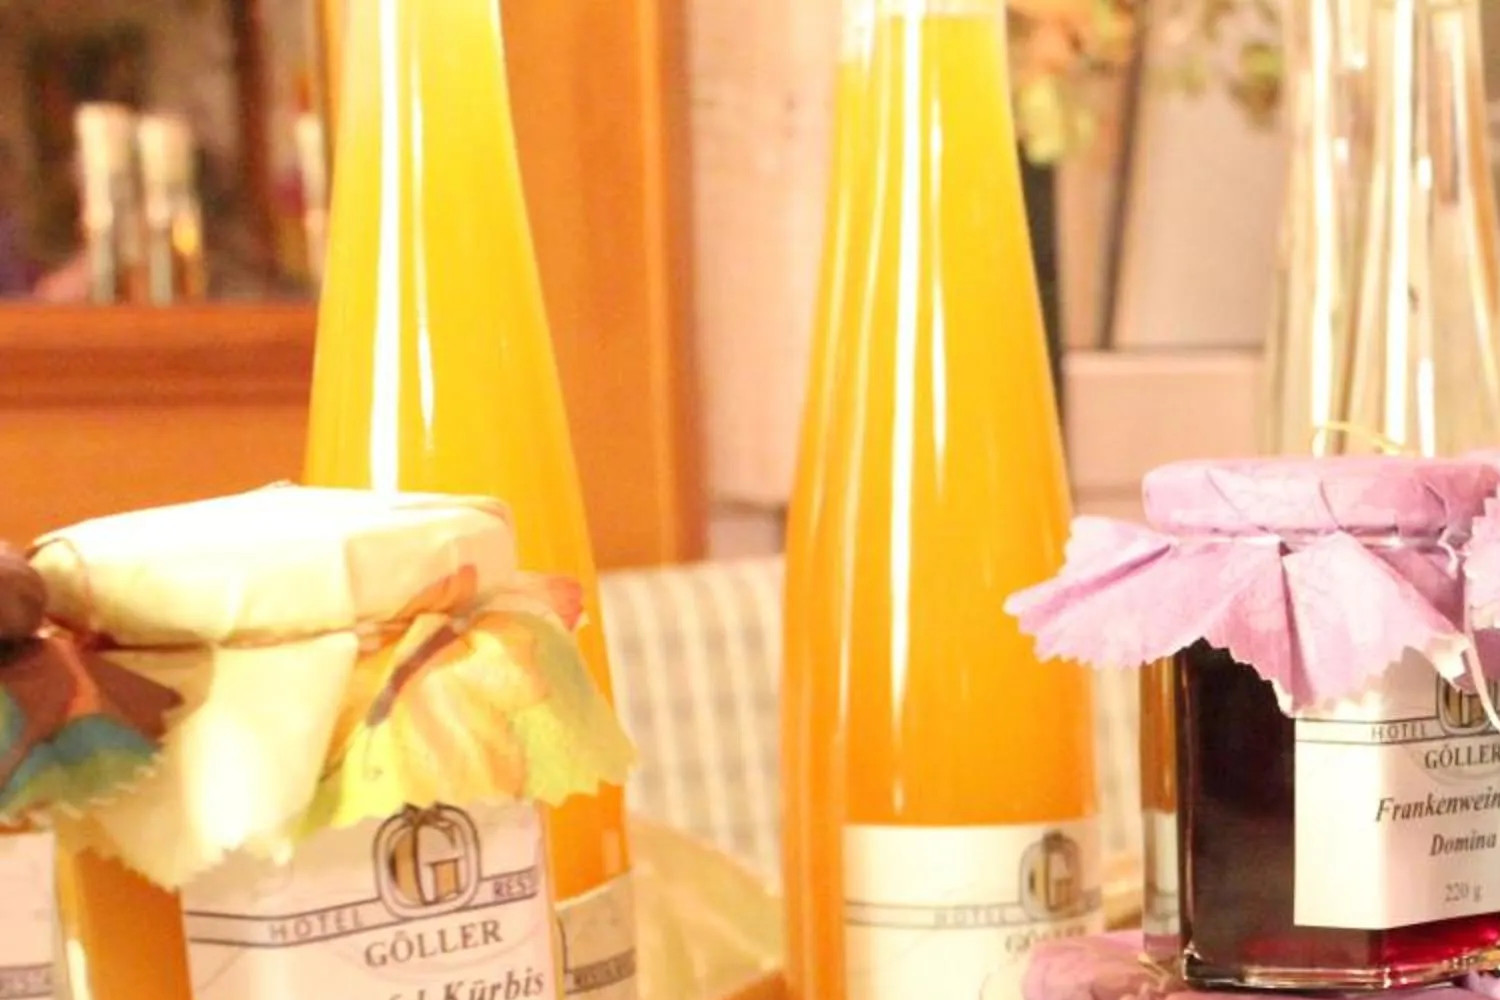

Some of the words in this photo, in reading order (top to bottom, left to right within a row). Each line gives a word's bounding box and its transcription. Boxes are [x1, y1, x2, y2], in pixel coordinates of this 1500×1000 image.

[1371, 722, 1428, 740] HOTEL
[1429, 828, 1497, 857] Domina
[1444, 881, 1469, 903] 220
[268, 907, 366, 942] HOTEL
[364, 917, 504, 970] GÖLLER
